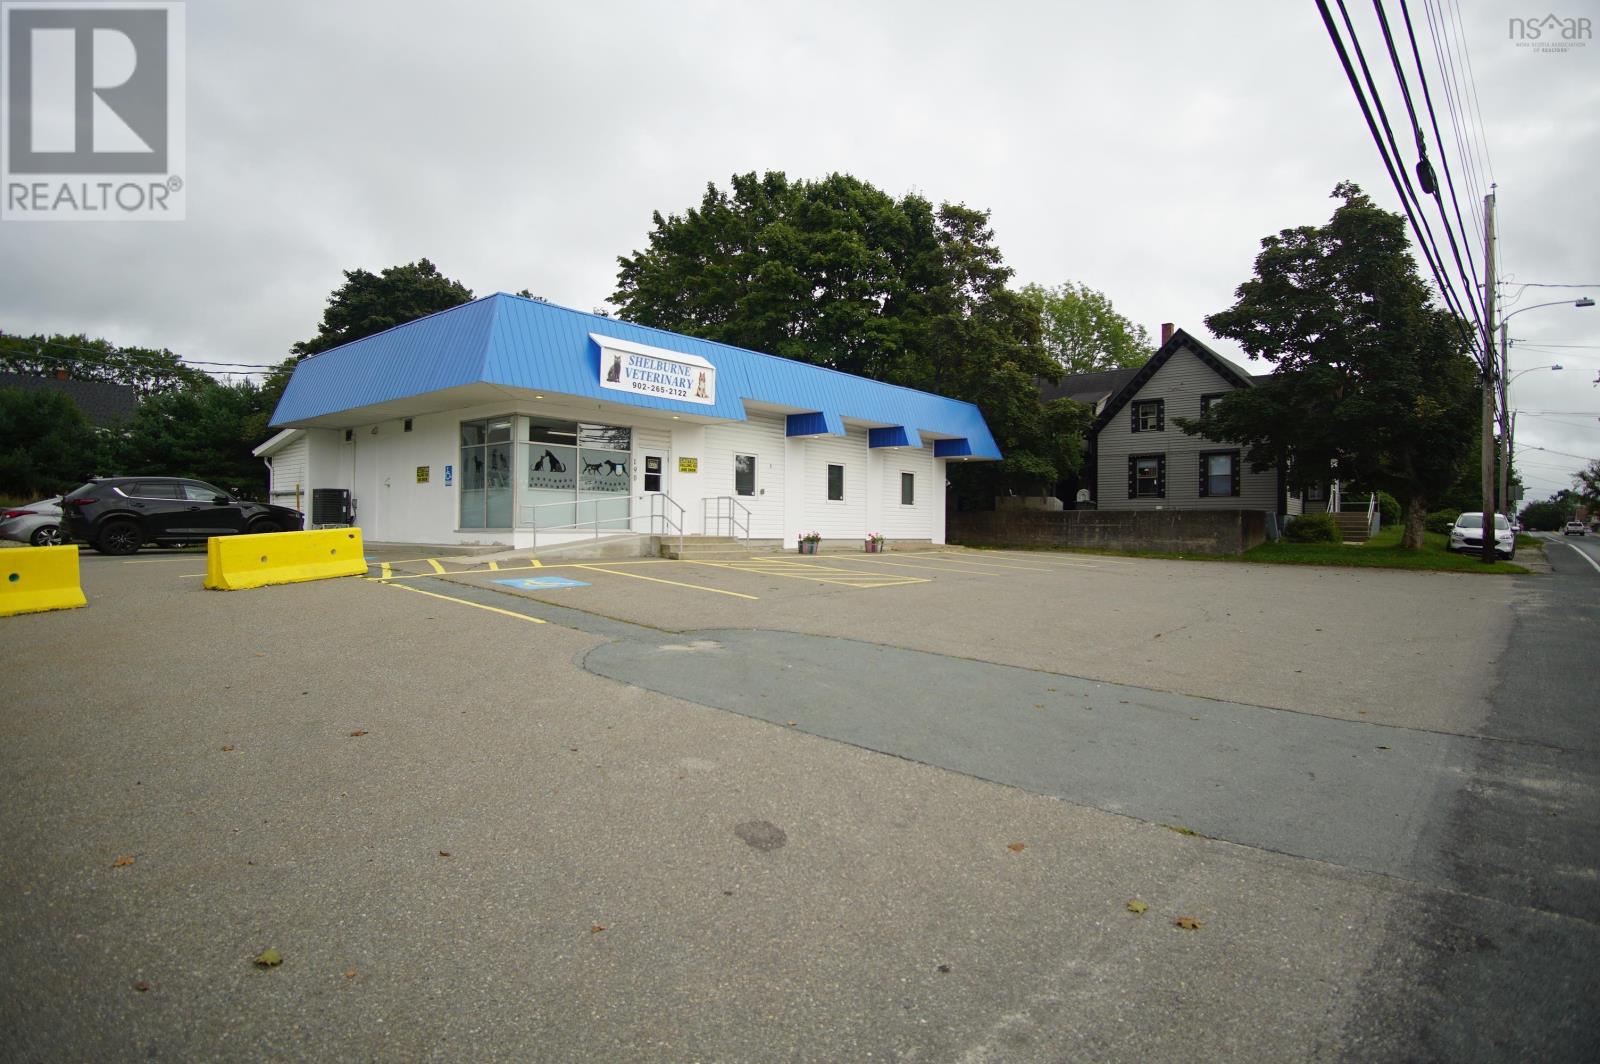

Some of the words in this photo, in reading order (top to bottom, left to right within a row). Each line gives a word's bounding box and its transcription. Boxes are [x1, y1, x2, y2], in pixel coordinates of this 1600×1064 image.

[628, 355, 691, 377] SHELBURNE
[624, 367, 694, 389] VETERINARY
[632, 381, 688, 397] 902-265-2122
